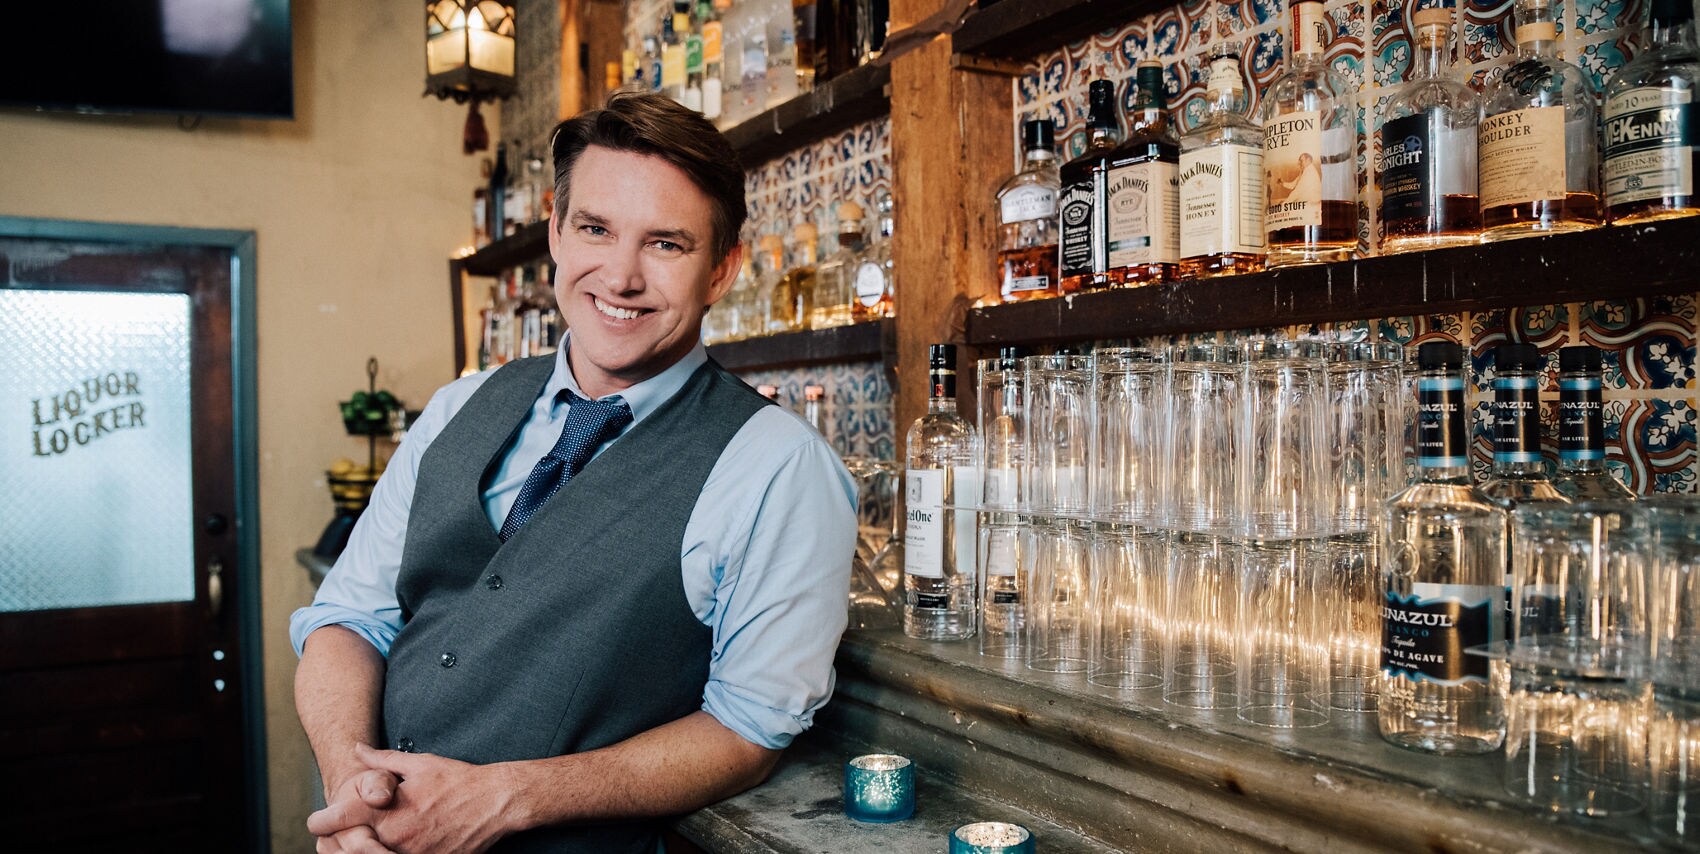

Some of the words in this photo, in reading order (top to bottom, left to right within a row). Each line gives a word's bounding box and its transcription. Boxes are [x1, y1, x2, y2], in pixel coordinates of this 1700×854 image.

[1625, 96, 1639, 109] 10
[1266, 133, 1290, 151] RYE
[1180, 167, 1196, 187] JACK
[1195, 161, 1223, 179] DANIEL'S
[1122, 176, 1149, 194] DANIEL'S
[1186, 209, 1216, 221] HONEY
[1283, 201, 1308, 212] STUFF
[31, 371, 141, 425] LIQUOR
[32, 401, 145, 457] LOCKER
[1381, 606, 1454, 627] UNAZUL
[1391, 635, 1416, 649] Tequila
[1393, 650, 1405, 658] DE
[1407, 652, 1444, 664] AGAVE
